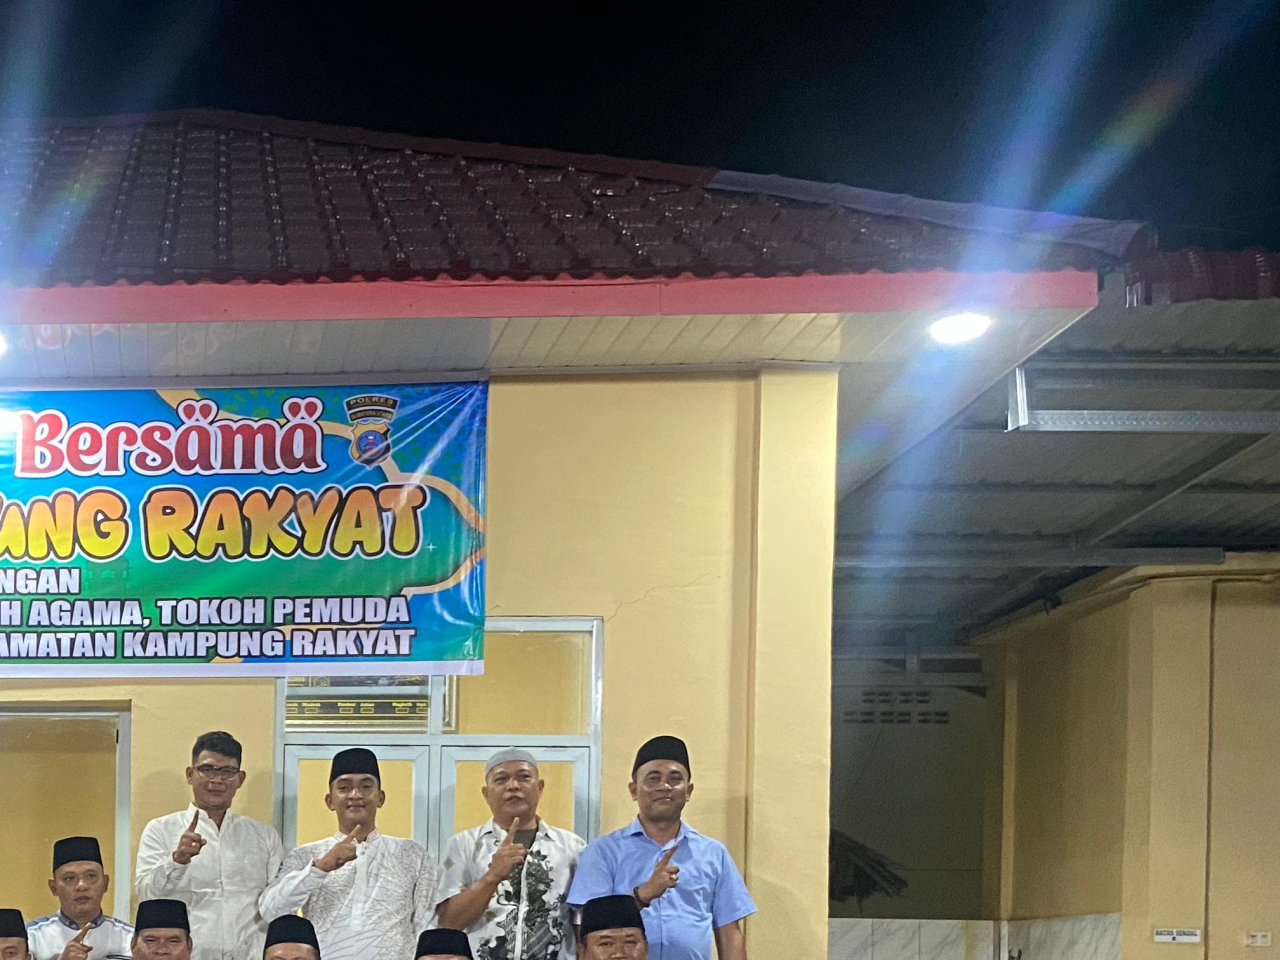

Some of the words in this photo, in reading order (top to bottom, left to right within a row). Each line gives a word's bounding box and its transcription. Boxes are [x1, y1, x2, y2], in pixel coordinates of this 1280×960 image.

[350, 397, 393, 405] POLRES
[143, 484, 429, 561] RAKYAT
[28, 599, 152, 628] AGAMA,
[157, 598, 266, 625] TOKOH
[274, 597, 410, 625] PEMUDA
[122, 629, 286, 658] KAMPUNG
[291, 628, 416, 656] RAKYAT
